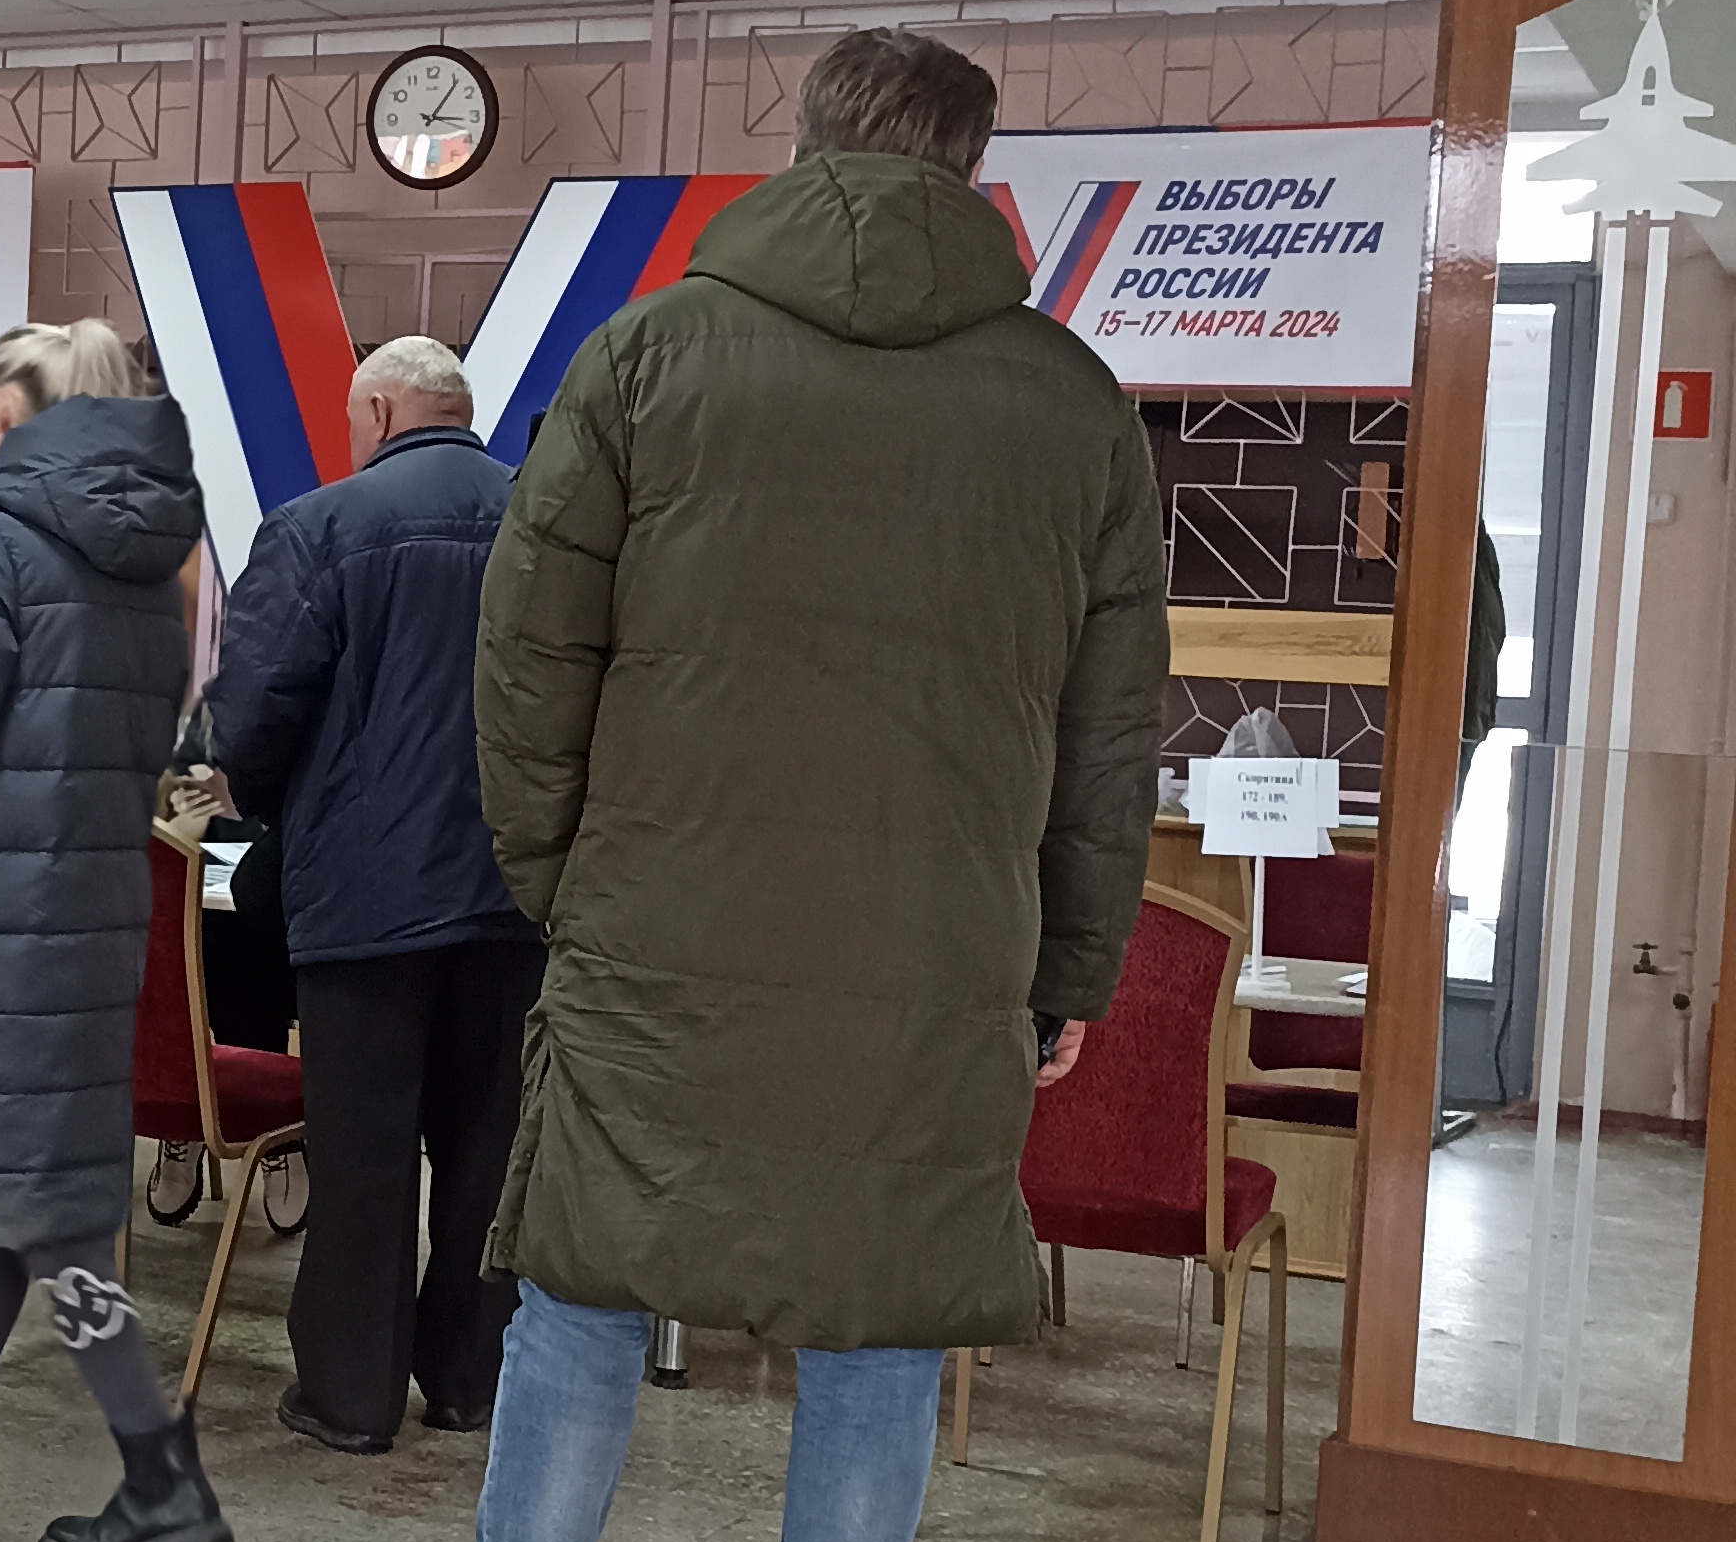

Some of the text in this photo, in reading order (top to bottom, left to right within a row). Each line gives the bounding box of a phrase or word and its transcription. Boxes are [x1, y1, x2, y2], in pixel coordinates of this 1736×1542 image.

[426, 66, 440, 79] 12
[407, 74, 417, 87] 11
[389, 89, 408, 104] 10
[464, 86, 475, 100] 2
[386, 113, 398, 127] 9
[469, 109, 481, 124] 3
[1156, 178, 1336, 211] ВЫБОРЫ
[1133, 222, 1384, 259] ПРЕЗИДЕНТА
[1111, 267, 1270, 299] РОССИИ
[1170, 310, 1267, 337] МАРТА
[1269, 310, 1341, 338] 2024
